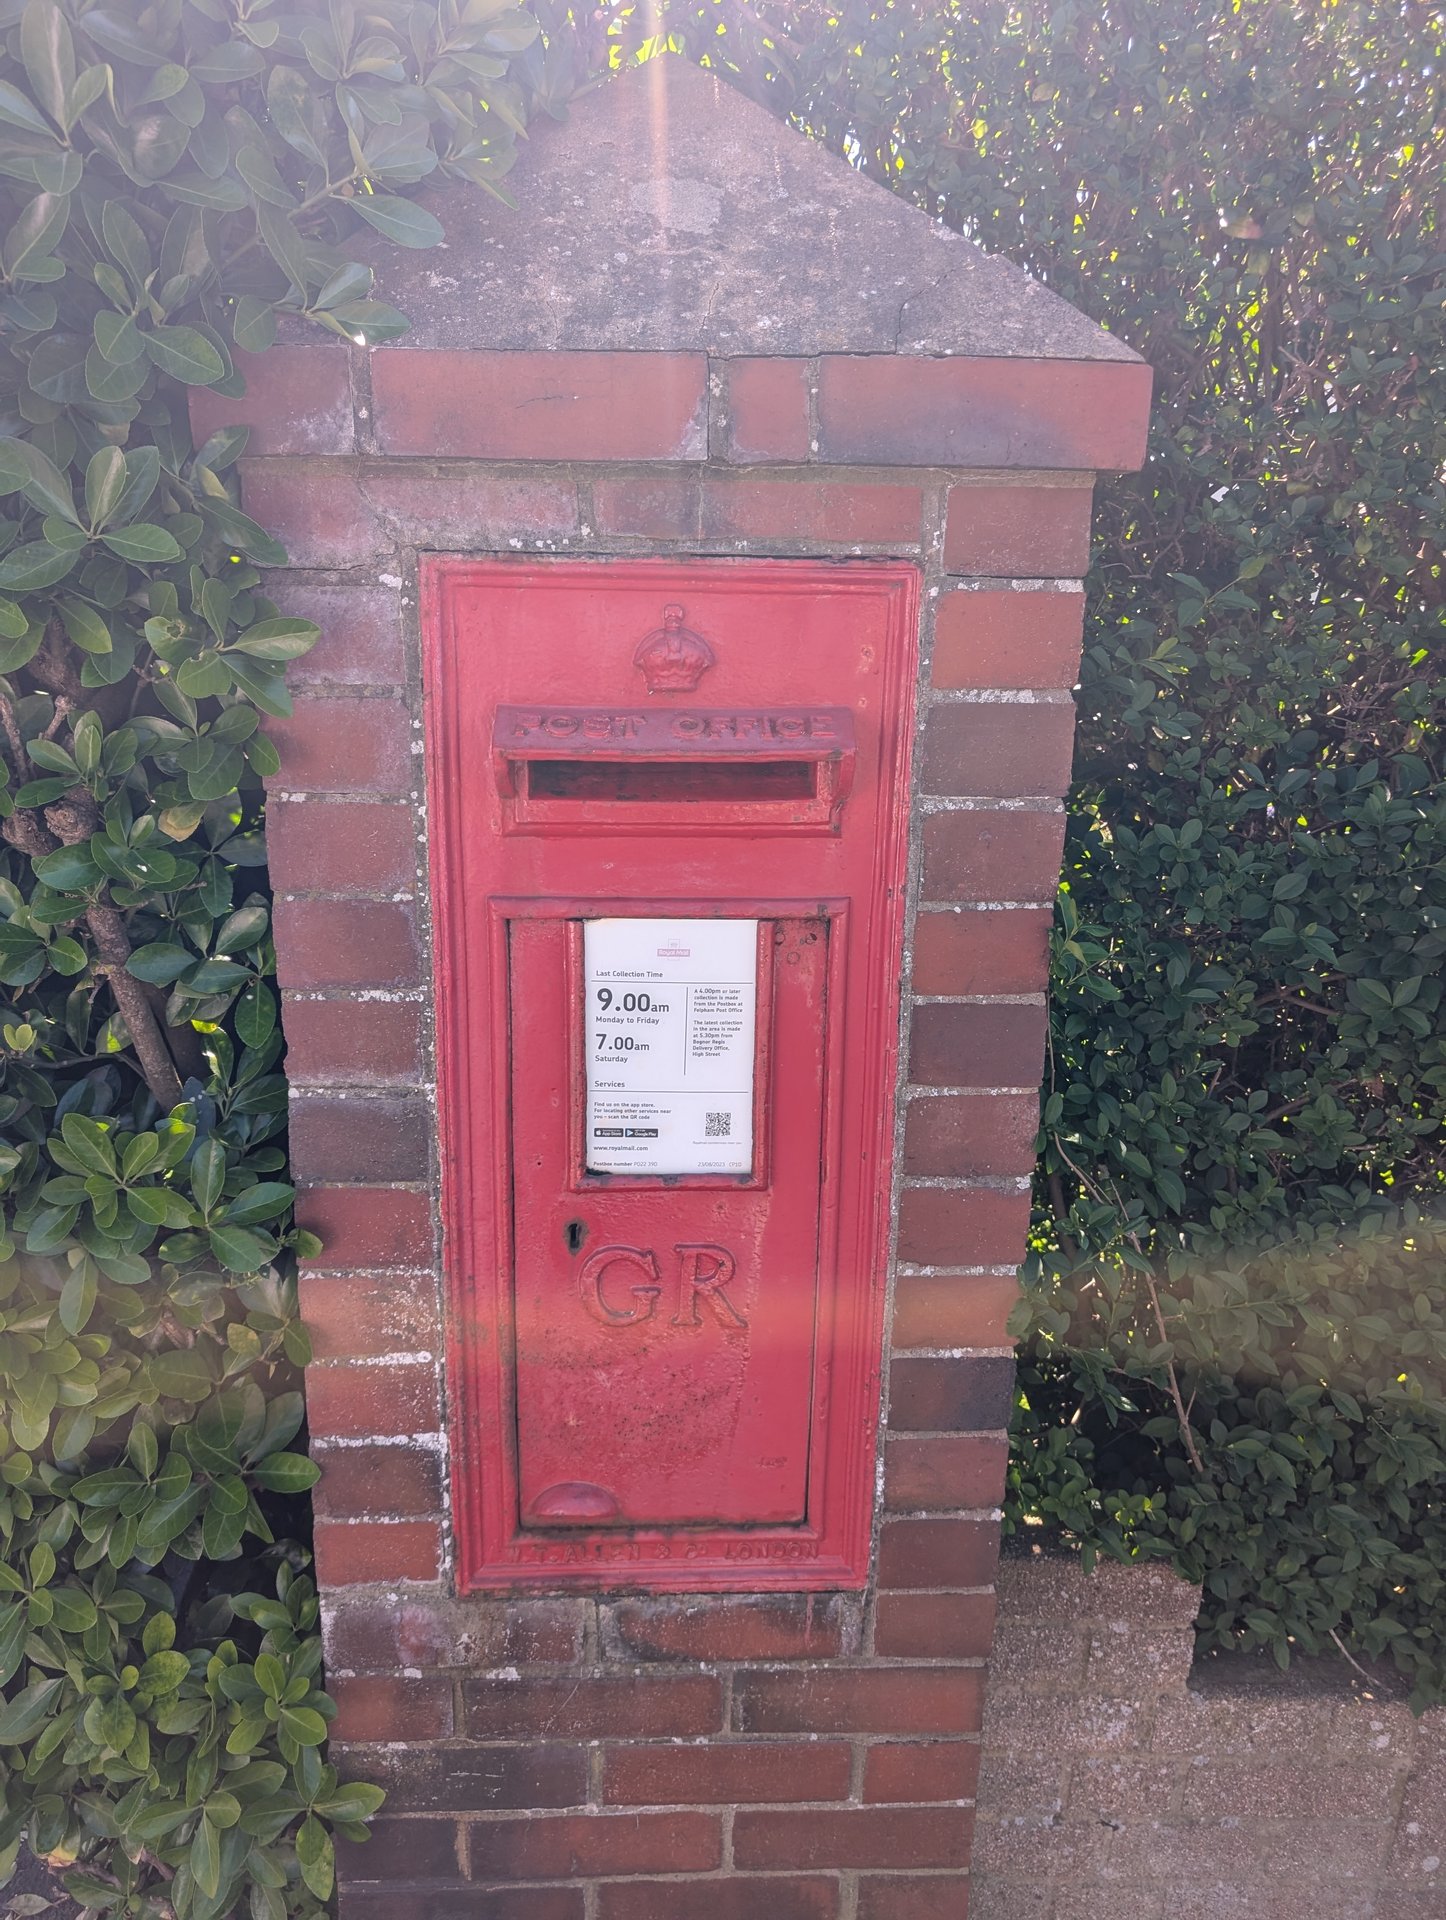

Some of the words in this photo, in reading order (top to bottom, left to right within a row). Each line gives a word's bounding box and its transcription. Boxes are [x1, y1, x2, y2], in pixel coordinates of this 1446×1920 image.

[514, 712, 647, 738] POST
[671, 714, 836, 739] OFFICE
[597, 988, 669, 1012] 9.00am
[596, 1016, 624, 1024] Monday
[637, 1017, 659, 1025] Friday
[596, 1034, 650, 1051] 7.00am
[595, 1055, 628, 1063] Saturday
[578, 1243, 748, 1328] GR
[725, 1542, 818, 1560] LONDON
